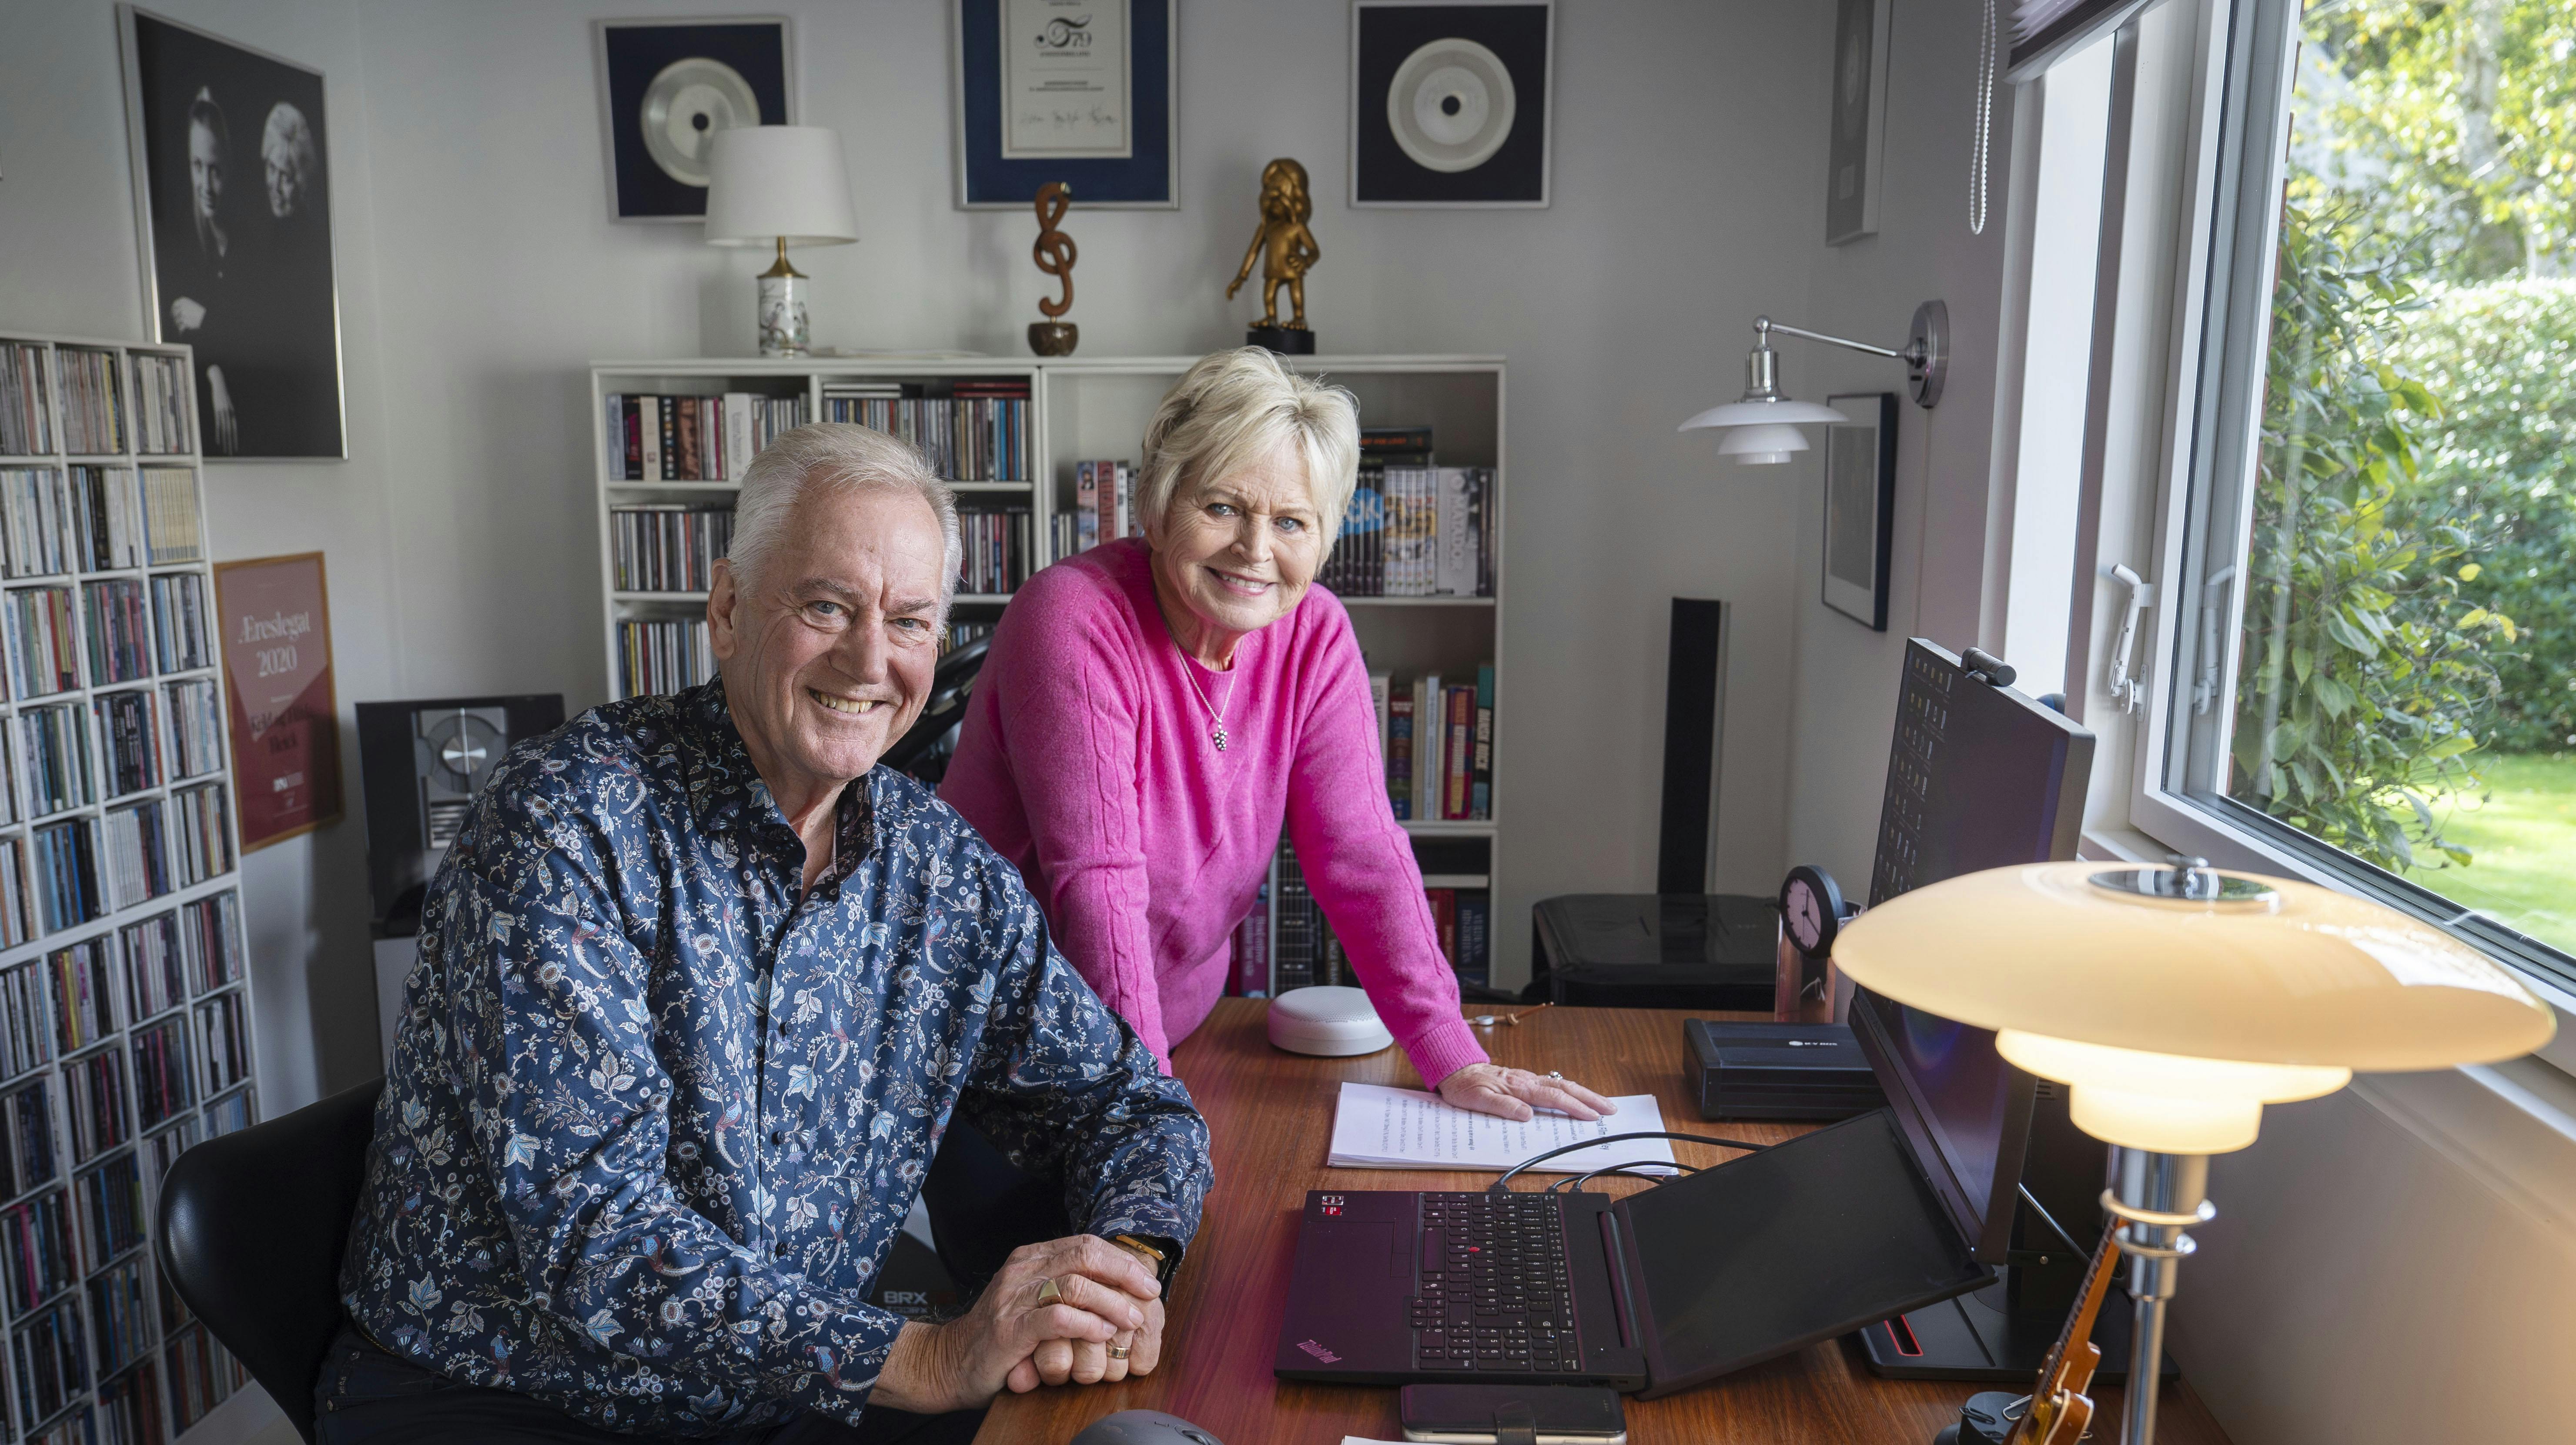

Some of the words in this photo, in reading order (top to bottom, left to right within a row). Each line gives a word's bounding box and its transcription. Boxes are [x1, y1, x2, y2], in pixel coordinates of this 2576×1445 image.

[237, 609, 311, 644] Æreslegat
[256, 645, 298, 678] 2020
[883, 1290, 928, 1305] BRX
[1296, 1339, 1342, 1364] ThinkPad
